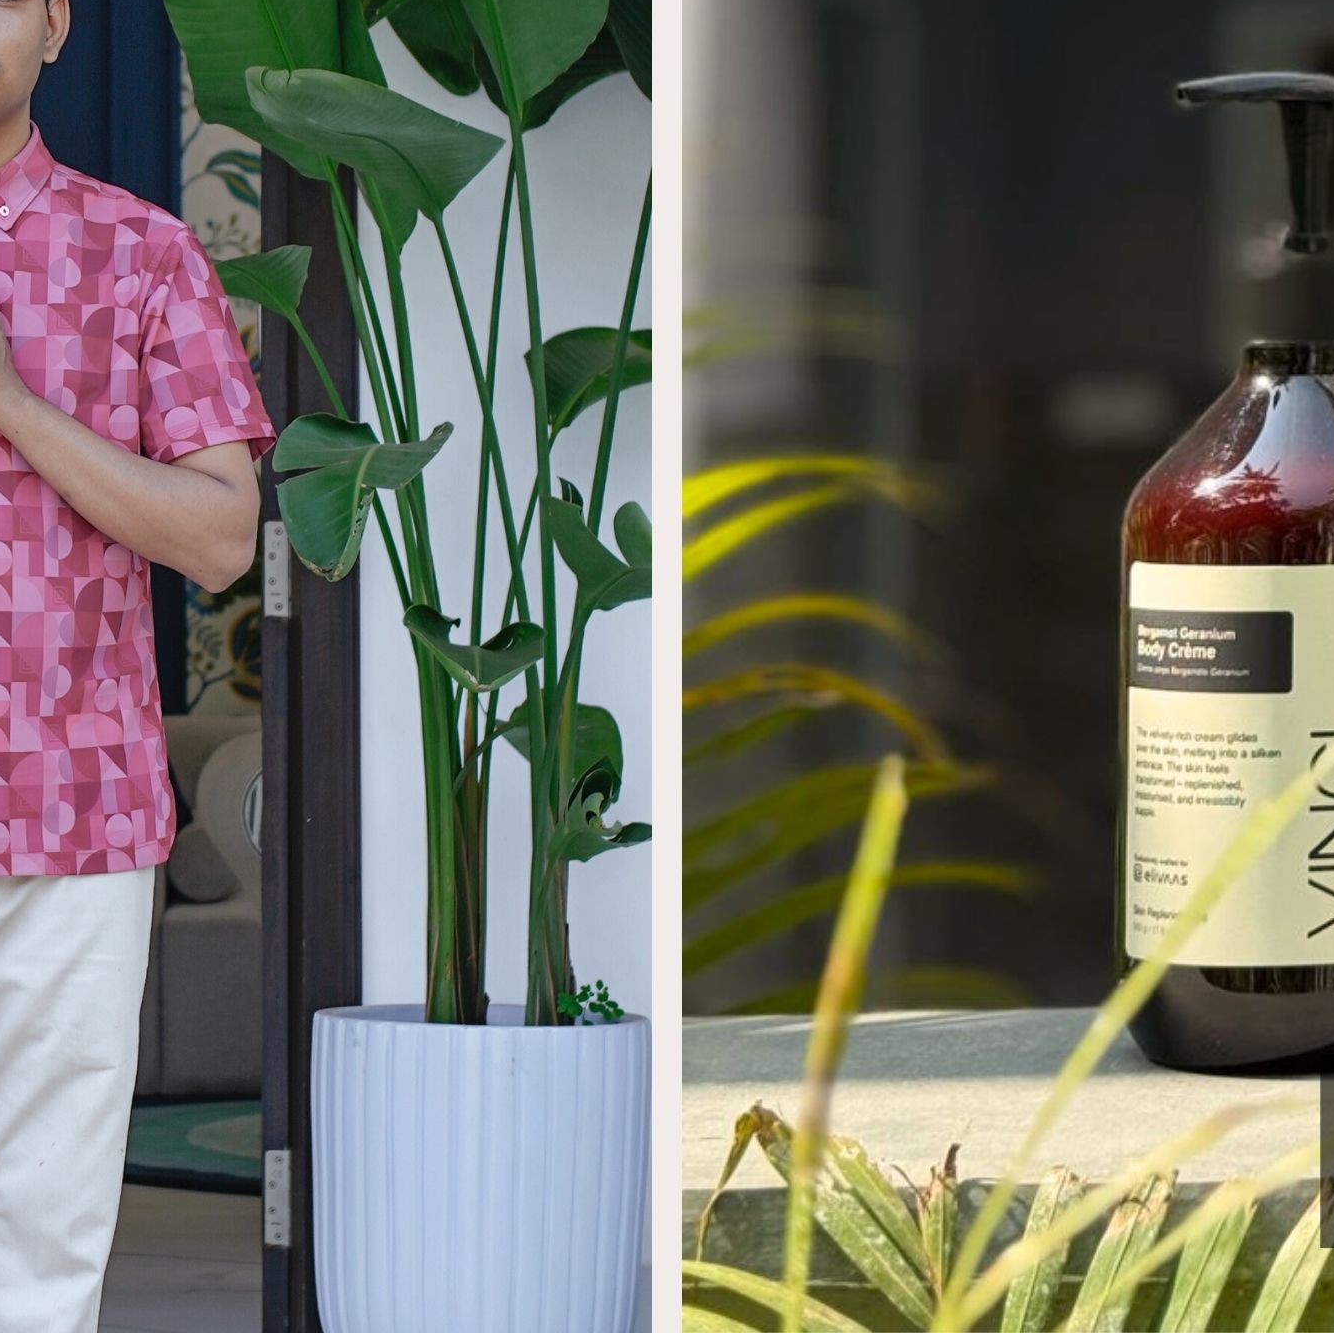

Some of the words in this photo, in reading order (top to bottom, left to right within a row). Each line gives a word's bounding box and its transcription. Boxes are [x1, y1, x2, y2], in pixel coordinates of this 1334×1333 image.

[1180, 627, 1236, 640] Geranium
[1137, 639, 1165, 661] Body
[1168, 642, 1216, 659] Crème
[1227, 733, 1258, 744] glides
